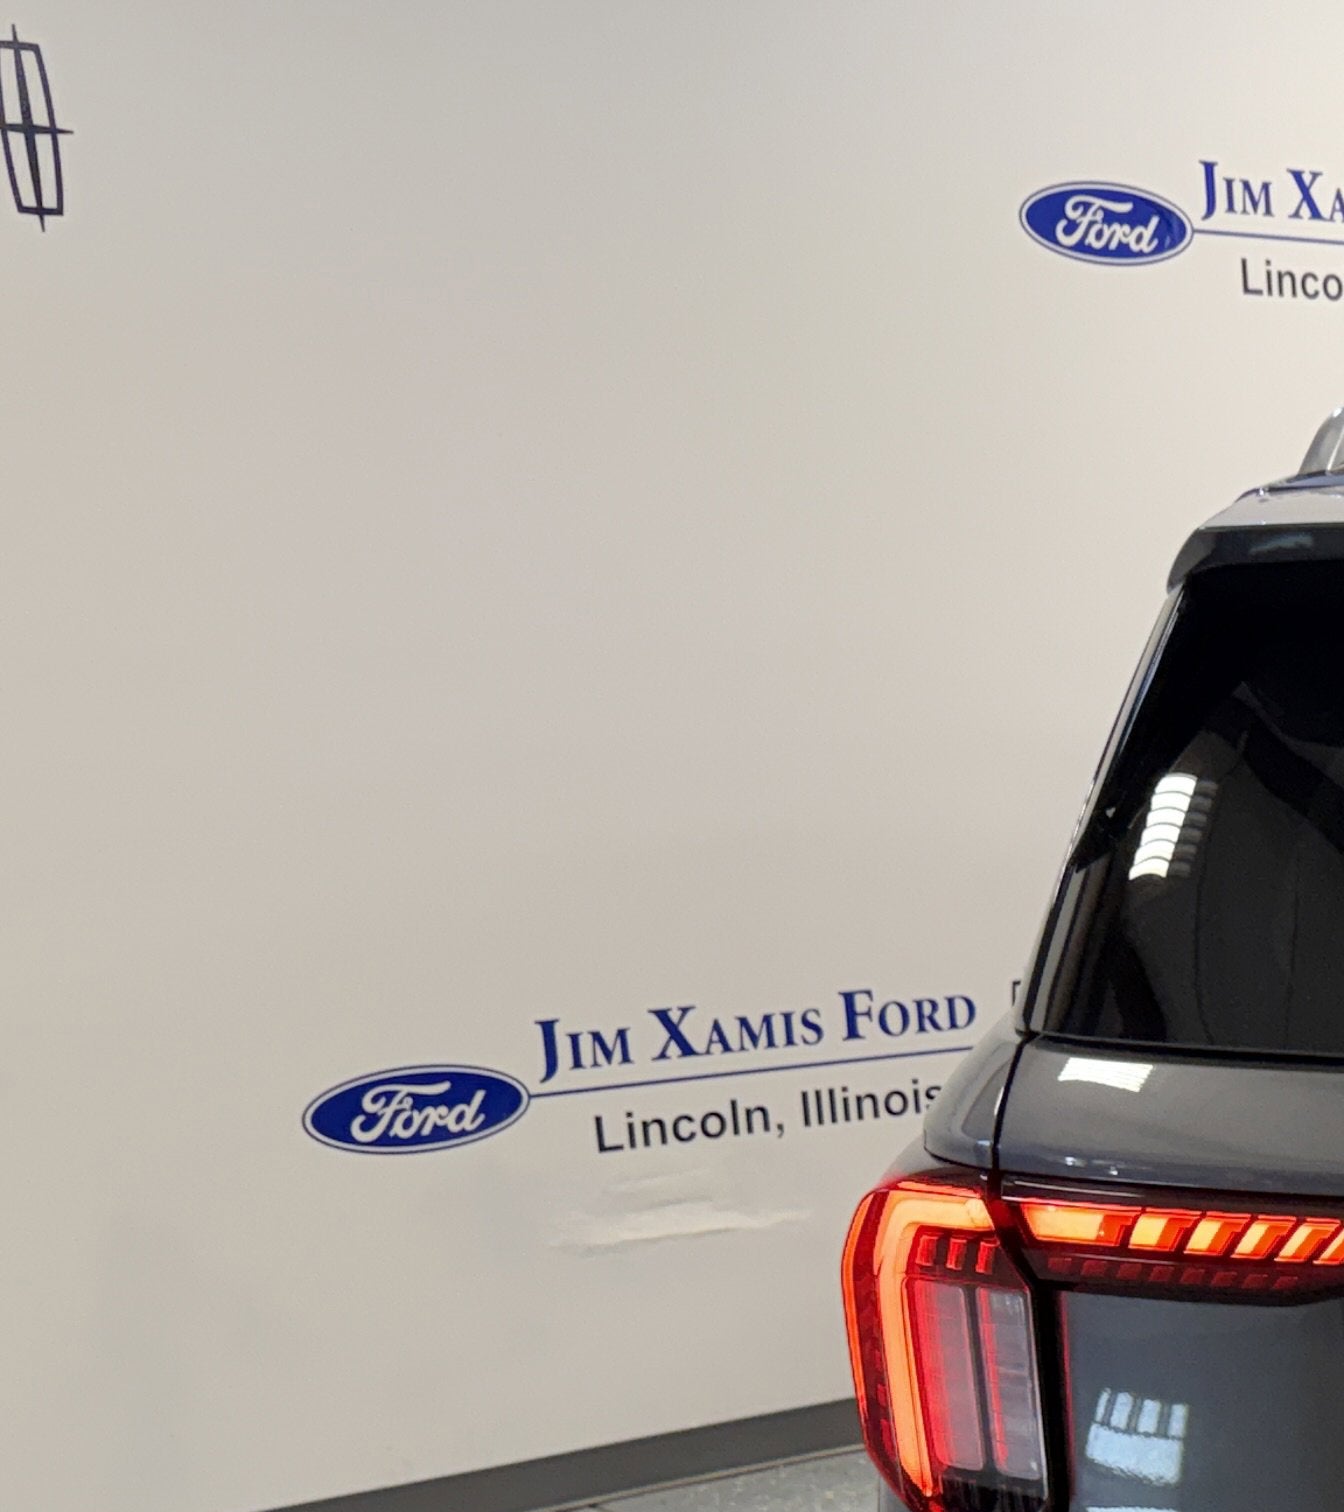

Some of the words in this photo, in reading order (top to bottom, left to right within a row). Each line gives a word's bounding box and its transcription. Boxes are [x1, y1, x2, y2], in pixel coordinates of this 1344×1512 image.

[1199, 160, 1273, 221] JIM
[1056, 194, 1160, 255] Ford
[534, 1018, 633, 1084] JIM
[647, 1005, 824, 1062] XAMIS
[837, 989, 977, 1042] FORD
[351, 1081, 486, 1143] Ford
[594, 1098, 785, 1154] Lincoln,
